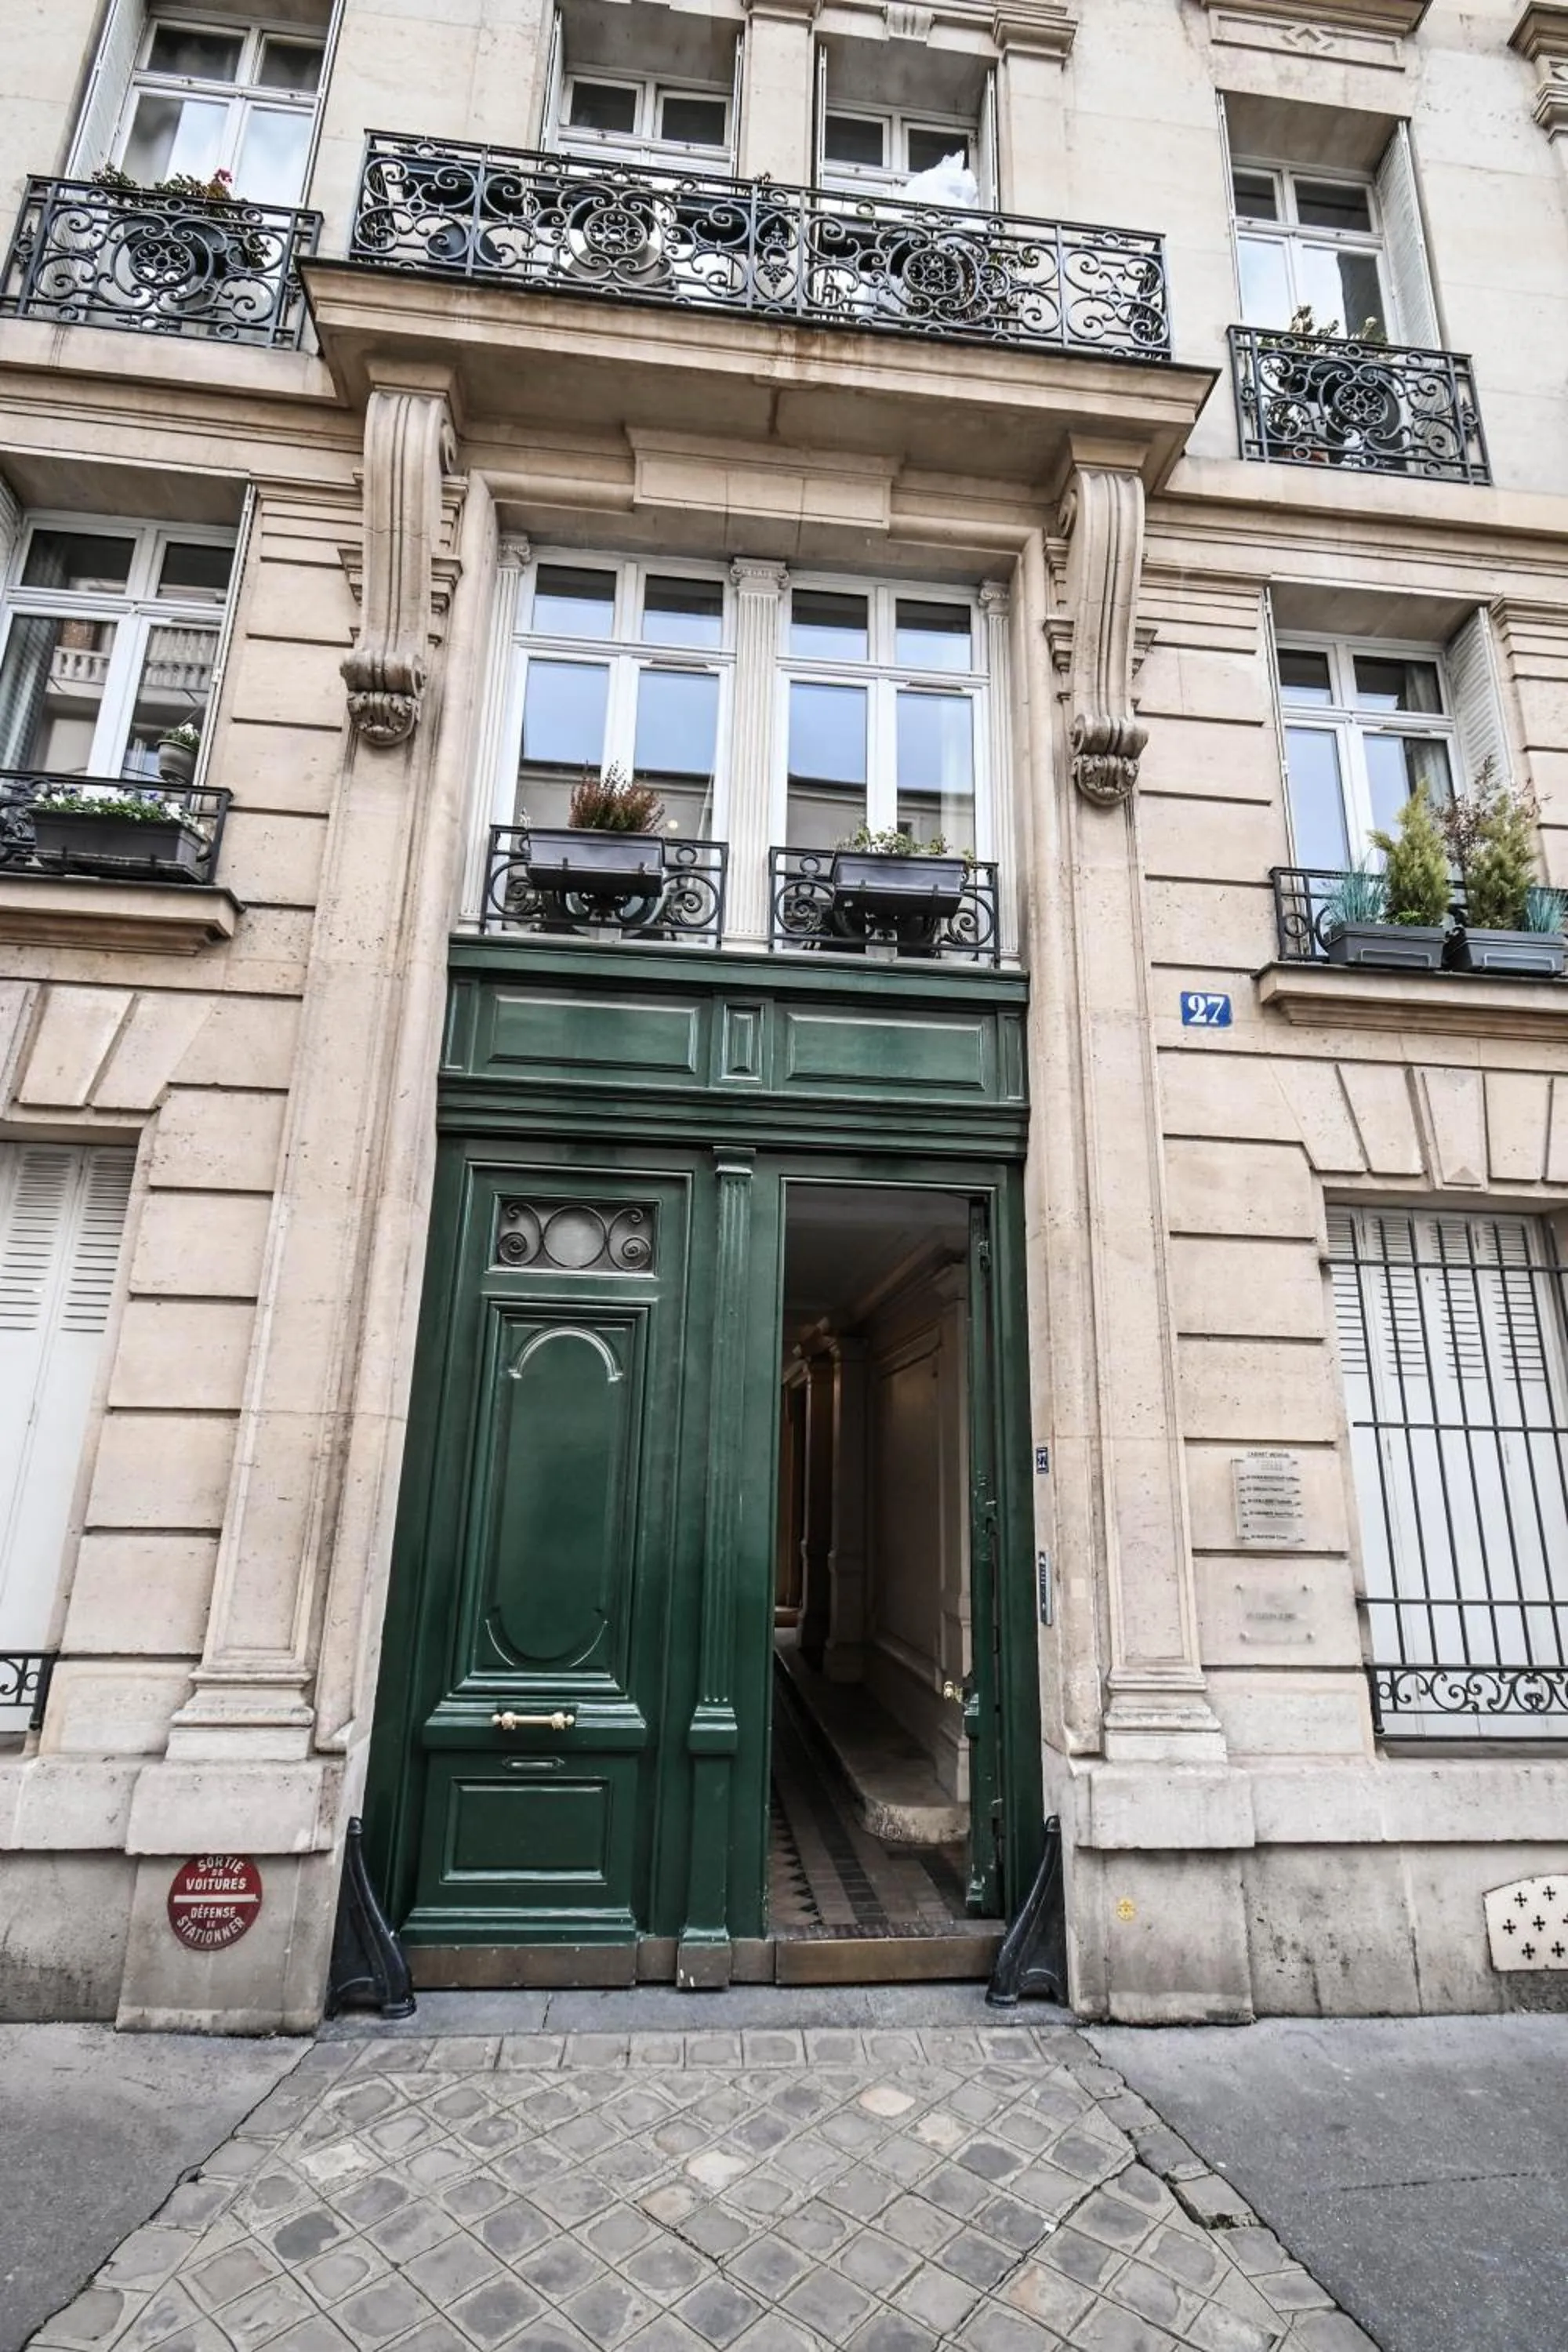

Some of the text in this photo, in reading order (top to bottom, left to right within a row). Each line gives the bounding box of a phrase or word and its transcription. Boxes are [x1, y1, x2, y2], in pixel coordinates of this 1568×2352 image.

[1188, 994, 1225, 1023] 27
[198, 1856, 245, 1874] SORTIE
[186, 1878, 247, 1890] VOITURES
[191, 1904, 236, 1918] DÉFENSE
[176, 1915, 245, 1944] STATIONNER
